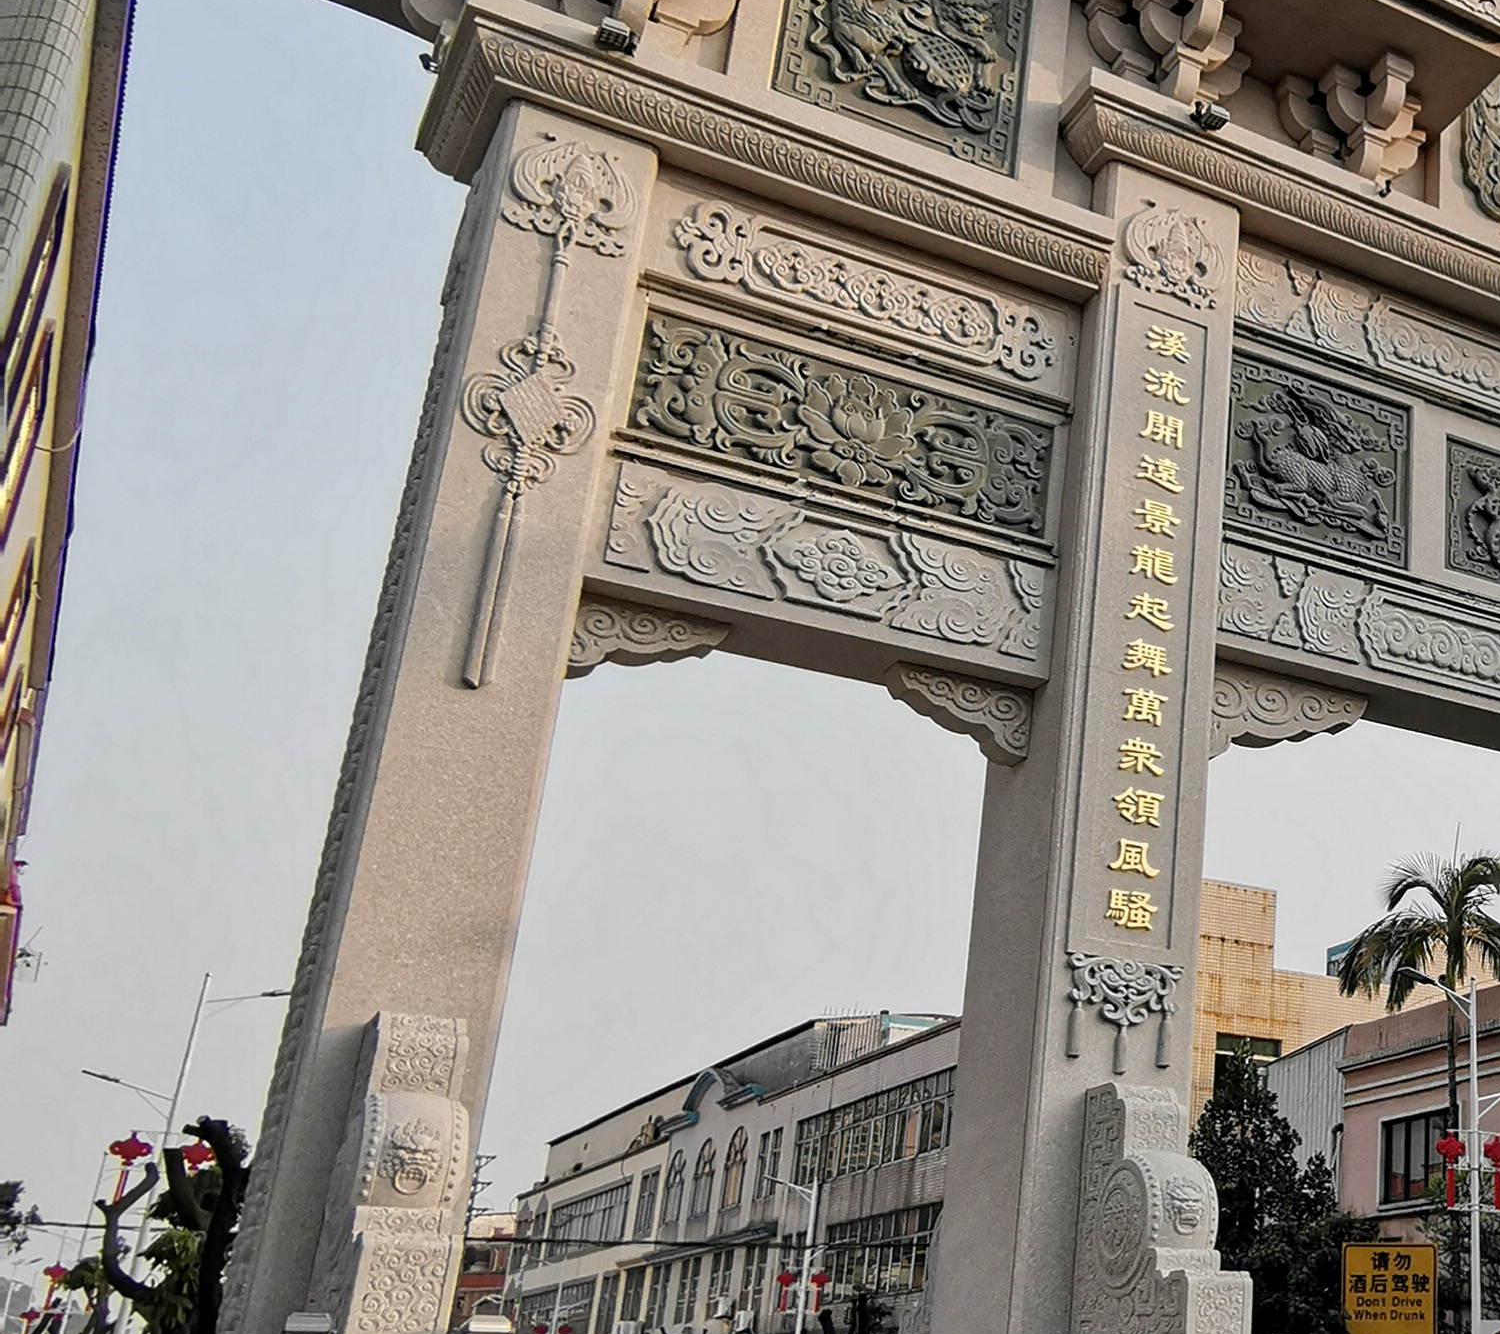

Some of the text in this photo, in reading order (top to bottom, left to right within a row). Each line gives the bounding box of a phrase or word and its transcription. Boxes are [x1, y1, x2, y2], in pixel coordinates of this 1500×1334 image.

[1371, 1251, 1411, 1271] 请勿
[1349, 1273, 1430, 1293] 酒后驾驶
[1392, 1296, 1423, 1307] Drive
[1354, 1309, 1425, 1321] When Drunk
